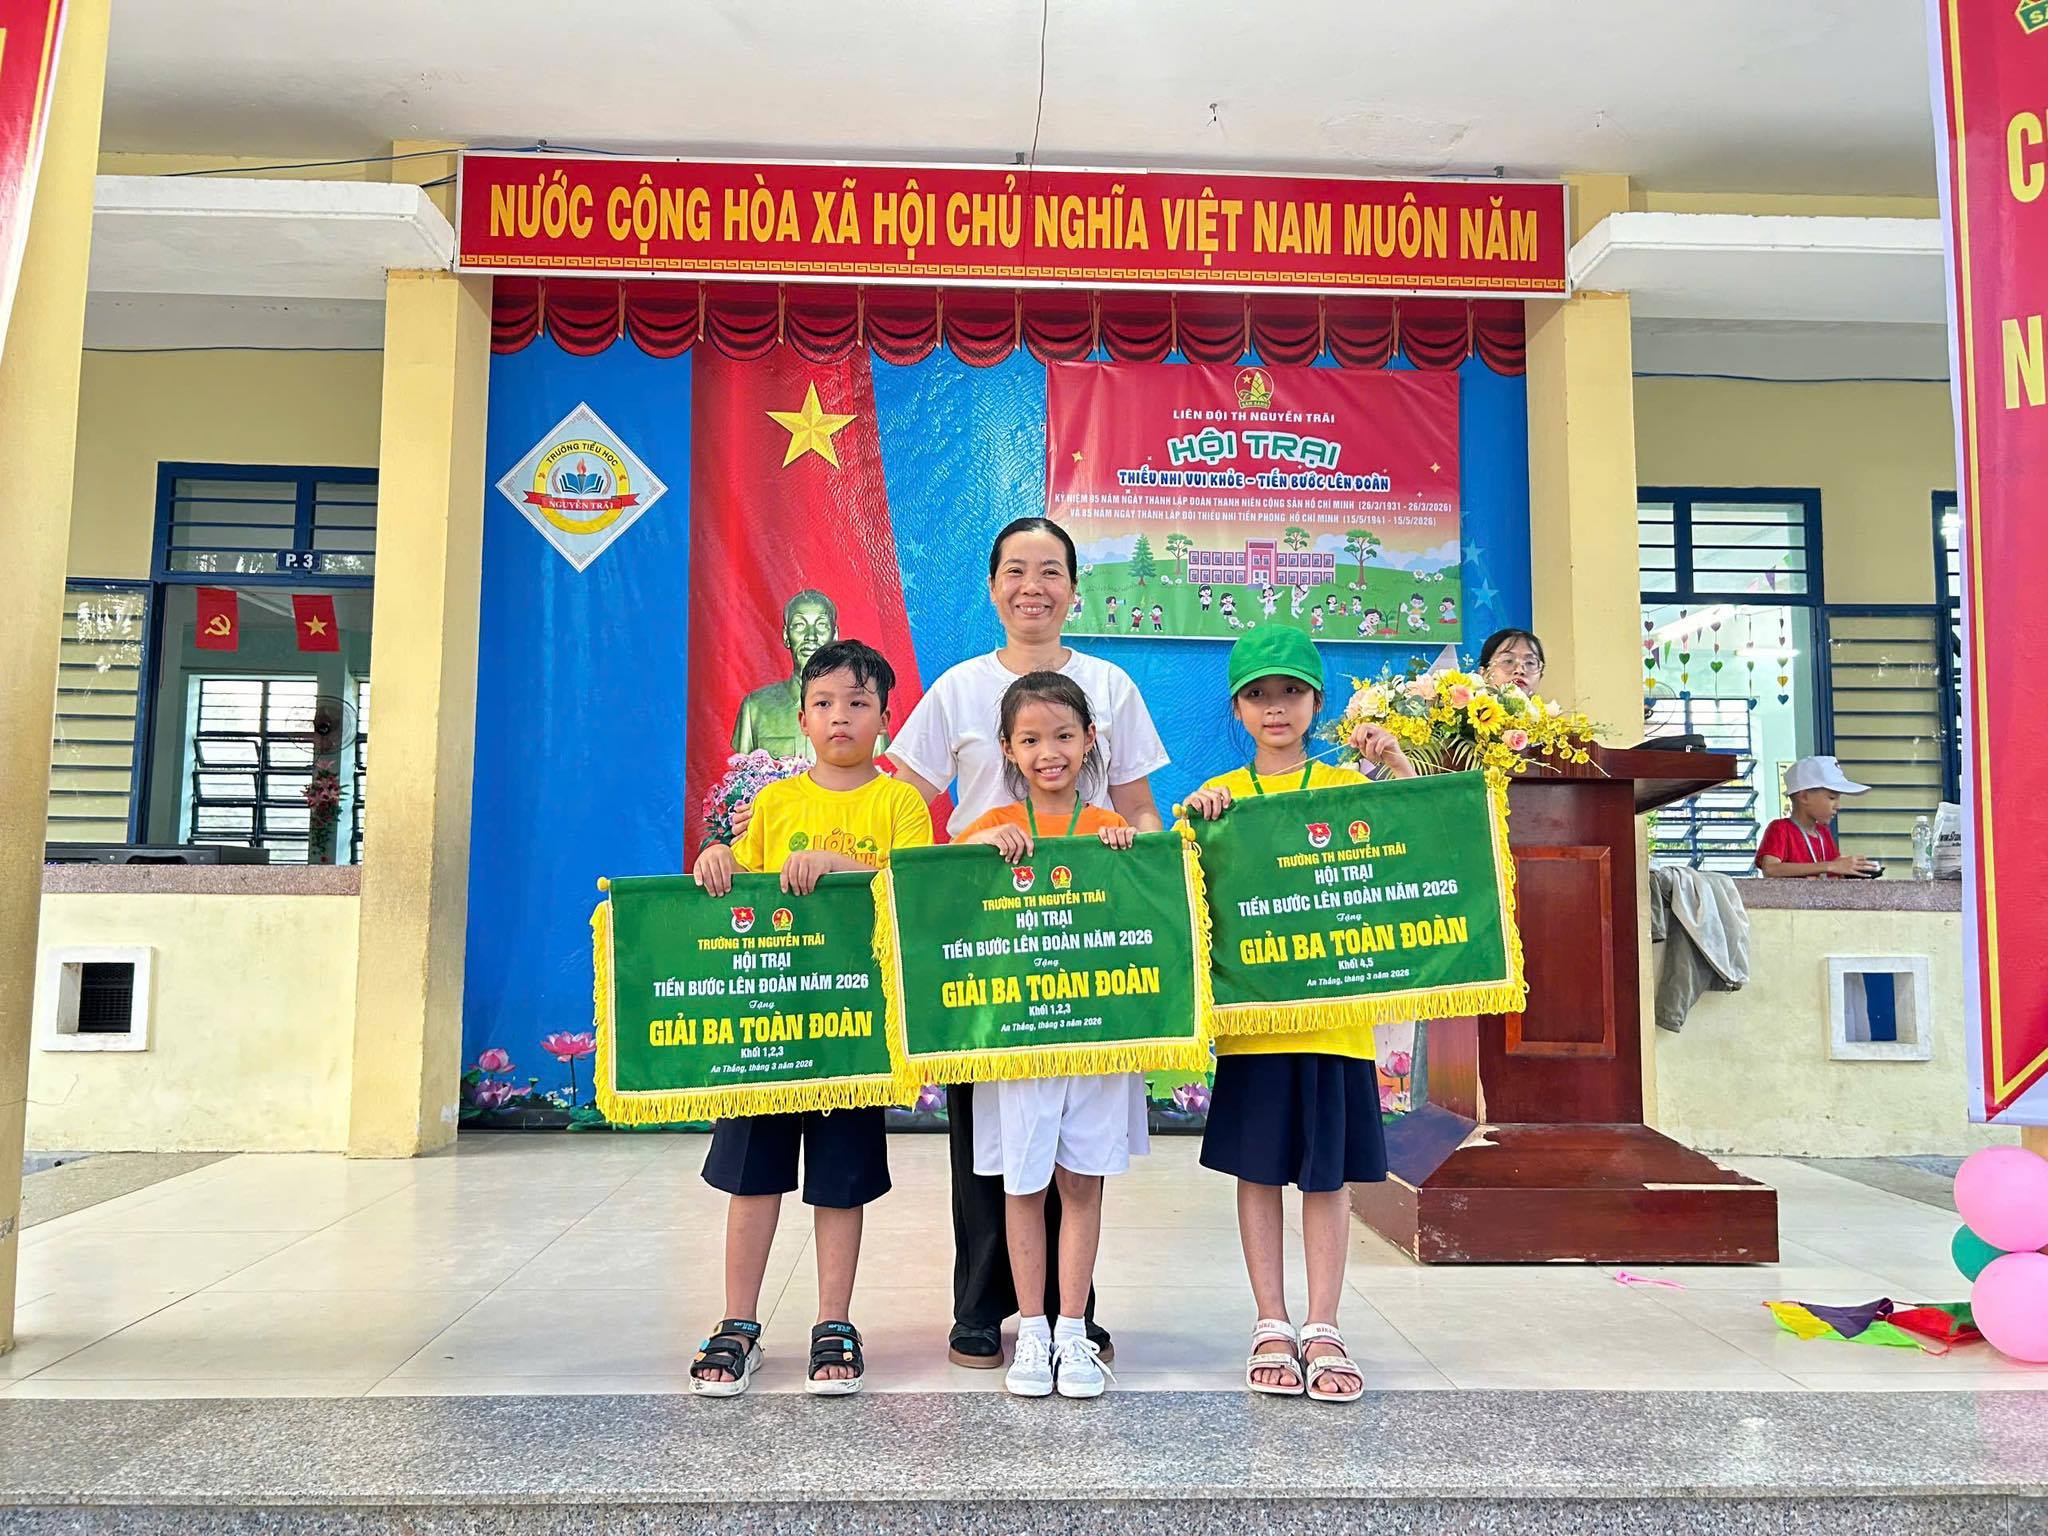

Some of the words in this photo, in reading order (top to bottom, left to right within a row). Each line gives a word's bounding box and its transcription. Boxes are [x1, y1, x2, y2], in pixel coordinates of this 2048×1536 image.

[2007, 112, 2048, 203] C
[490, 170, 593, 239] NƯỚC
[607, 174, 711, 255] CỘNG
[724, 173, 800, 243] HÒA
[811, 178, 861, 244] XÃ
[873, 179, 936, 261] HỘI
[946, 174, 1021, 247] CHỦ
[1035, 185, 1149, 250] NGHĨA
[1161, 187, 1243, 266] VIỆT
[1253, 201, 1332, 254] NAM
[1344, 192, 1448, 260] MUÔN
[1460, 196, 1538, 262] NĂM
[1173, 408, 1202, 420] LIÊN
[1206, 409, 1227, 421] ĐỘI
[1231, 412, 1246, 421] TH
[1251, 409, 1302, 422] NGUYỄN
[1307, 413, 1334, 423] TRÃI
[546, 442, 580, 464] TRƯỜNG
[582, 441, 602, 453] TIỂU
[602, 450, 619, 467] HỌC
[1170, 429, 1235, 462] HỘI
[1245, 433, 1338, 466] TRẠI
[1119, 466, 1156, 486] THIẾU
[1160, 471, 1181, 486] NHI
[1185, 472, 1206, 486] VUI
[1209, 469, 1243, 487] KHỎE
[1258, 468, 1287, 488] TIẾN
[1292, 471, 1324, 489] BƯỚC
[1328, 472, 1351, 490] LÊN
[1356, 473, 1389, 491] ĐOÀN
[285, 554, 298, 567] P.
[303, 554, 313, 568] 3
[1277, 853, 1320, 868] TRƯỜNG
[1322, 852, 1335, 863] TH
[1337, 844, 1379, 862] NGUYỄN
[1381, 842, 1406, 856] TRÃI
[1315, 865, 1338, 886] HỘI
[1341, 863, 1373, 883] TRẠI
[982, 897, 1021, 911] TRƯỜNG
[1024, 896, 1036, 907] TH
[1039, 890, 1080, 907] NGUYỄN
[1083, 890, 1106, 903] TRÃI
[1238, 895, 1270, 917] TIẾN
[1273, 891, 1311, 914] BƯỚC
[1314, 888, 1341, 909] LÊN
[1344, 885, 1382, 906] ĐOÀN
[1386, 882, 1419, 902] NĂM
[1423, 879, 1458, 897] 2026
[1016, 909, 1039, 932] HỘI
[1042, 909, 1072, 930] TRẠI
[698, 935, 740, 950] TRƯỜNG
[743, 938, 755, 949] TH
[758, 931, 800, 948] NGUYỄN
[802, 933, 825, 946] TRÃI
[942, 938, 973, 960] TIẾN
[976, 935, 1010, 957] BƯỚC
[1014, 935, 1039, 953] LÊN
[1042, 932, 1080, 952] ĐOÀN
[1084, 929, 1116, 948] NĂM
[1119, 929, 1153, 946] 2026
[1240, 929, 1288, 965] GIẢI
[1293, 931, 1327, 961] BA
[1329, 921, 1394, 955] TOÀN
[1400, 913, 1468, 946] ĐOÀN
[733, 951, 756, 972] HỘI
[760, 952, 791, 971] TRẠI
[1338, 957, 1358, 970] Khối
[1359, 957, 1374, 968] 4,5
[654, 977, 685, 997] TIẾN
[688, 976, 725, 996] BƯỚC
[729, 976, 755, 995] LÊN
[759, 974, 797, 994] ĐOÀN
[801, 973, 831, 991] NĂM
[836, 974, 869, 989] 2026
[942, 973, 987, 1008] GIẢI
[992, 976, 1021, 1005] BA
[1026, 969, 1090, 1002] TOÀN
[1095, 963, 1160, 996] ĐOÀN
[1307, 978, 1317, 987] An
[1344, 973, 1365, 984] tháng
[1373, 970, 1389, 979] năm
[1391, 968, 1410, 978] 2026
[1029, 1004, 1048, 1016] Khối
[1050, 1004, 1071, 1015] 1,2,3
[649, 1012, 697, 1046] GIẢI
[703, 1019, 735, 1045] BA
[740, 1011, 803, 1043] TOÀN
[809, 1007, 872, 1038] ĐOÀN
[1001, 1024, 1011, 1032] An
[1038, 1021, 1058, 1031] tháng
[1066, 1019, 1082, 1027] năm
[1084, 1018, 1102, 1026] 2026
[741, 1045, 760, 1059] Khối
[763, 1046, 784, 1058] 1,2,3
[711, 1064, 721, 1073] An
[749, 1063, 770, 1074] tháng
[778, 1062, 794, 1070] năm
[795, 1060, 813, 1068] 2026
